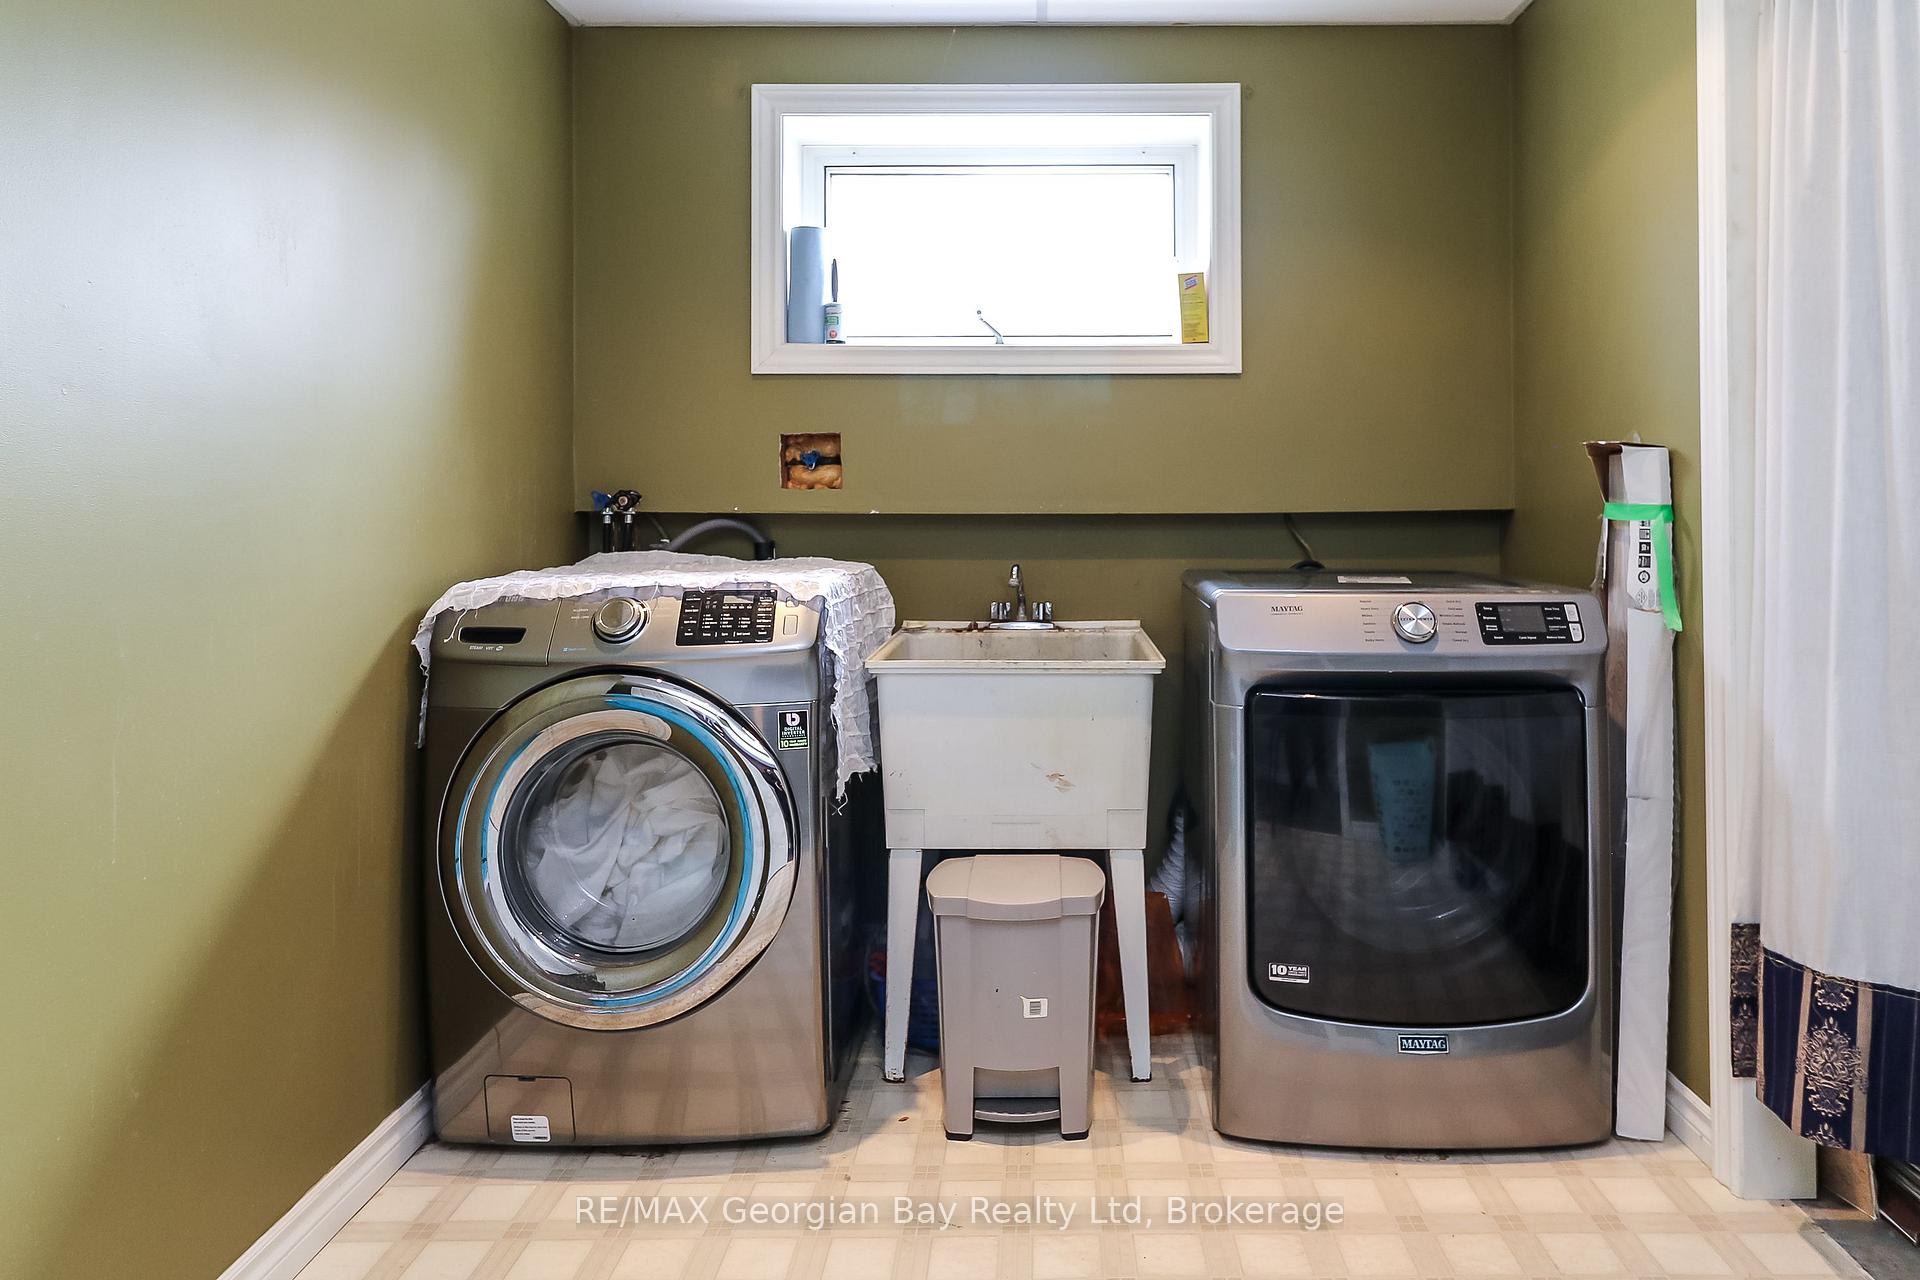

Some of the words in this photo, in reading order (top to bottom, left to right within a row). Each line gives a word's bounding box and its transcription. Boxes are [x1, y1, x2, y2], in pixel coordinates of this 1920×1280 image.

[780, 740, 789, 748] 10
[1271, 964, 1288, 976] 10
[1401, 1039, 1446, 1049] MAYTAG
